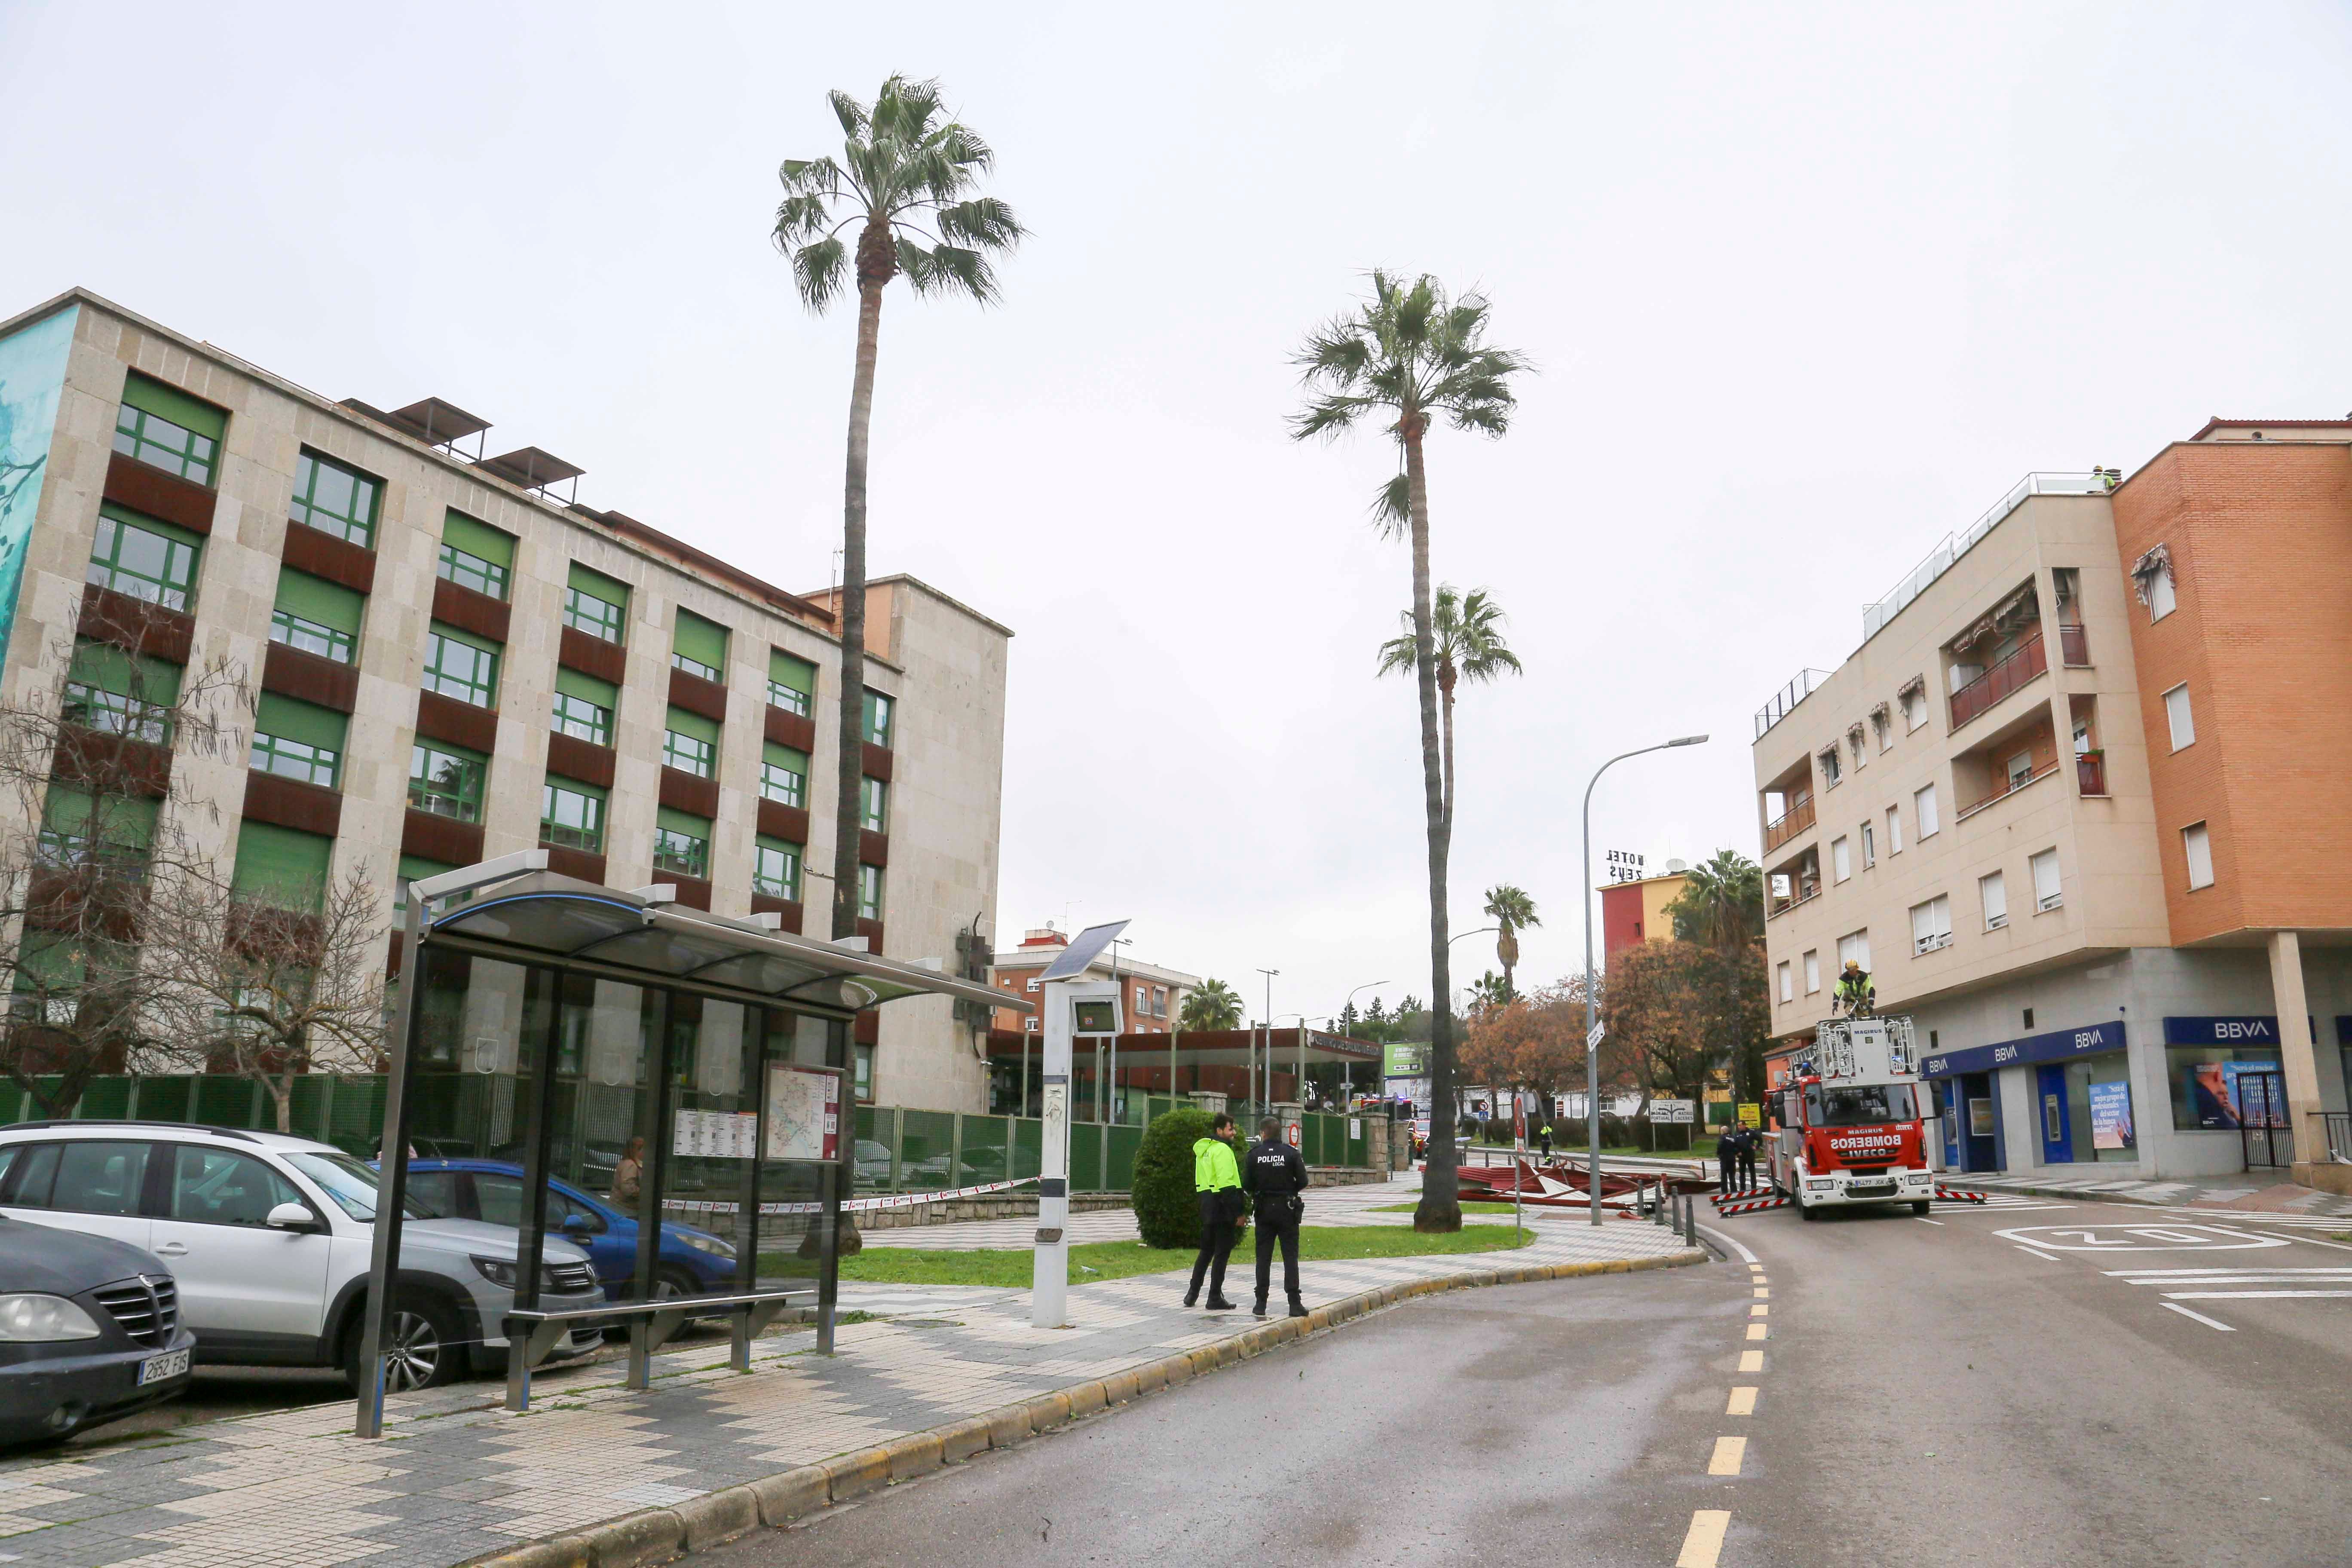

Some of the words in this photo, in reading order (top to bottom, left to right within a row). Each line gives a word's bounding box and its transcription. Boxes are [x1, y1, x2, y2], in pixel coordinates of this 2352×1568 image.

[2215, 1021, 2269, 1038] BBVA
[2075, 1029, 2103, 1048] BBVA
[1995, 1044, 2018, 1062] BBVA
[1929, 1057, 1948, 1073] BBVA
[1258, 1155, 1285, 1163] POLICIA
[1848, 1148, 1886, 1157] IVECO
[2051, 1229, 2213, 1244] 20
[145, 1358, 170, 1381] 2652
